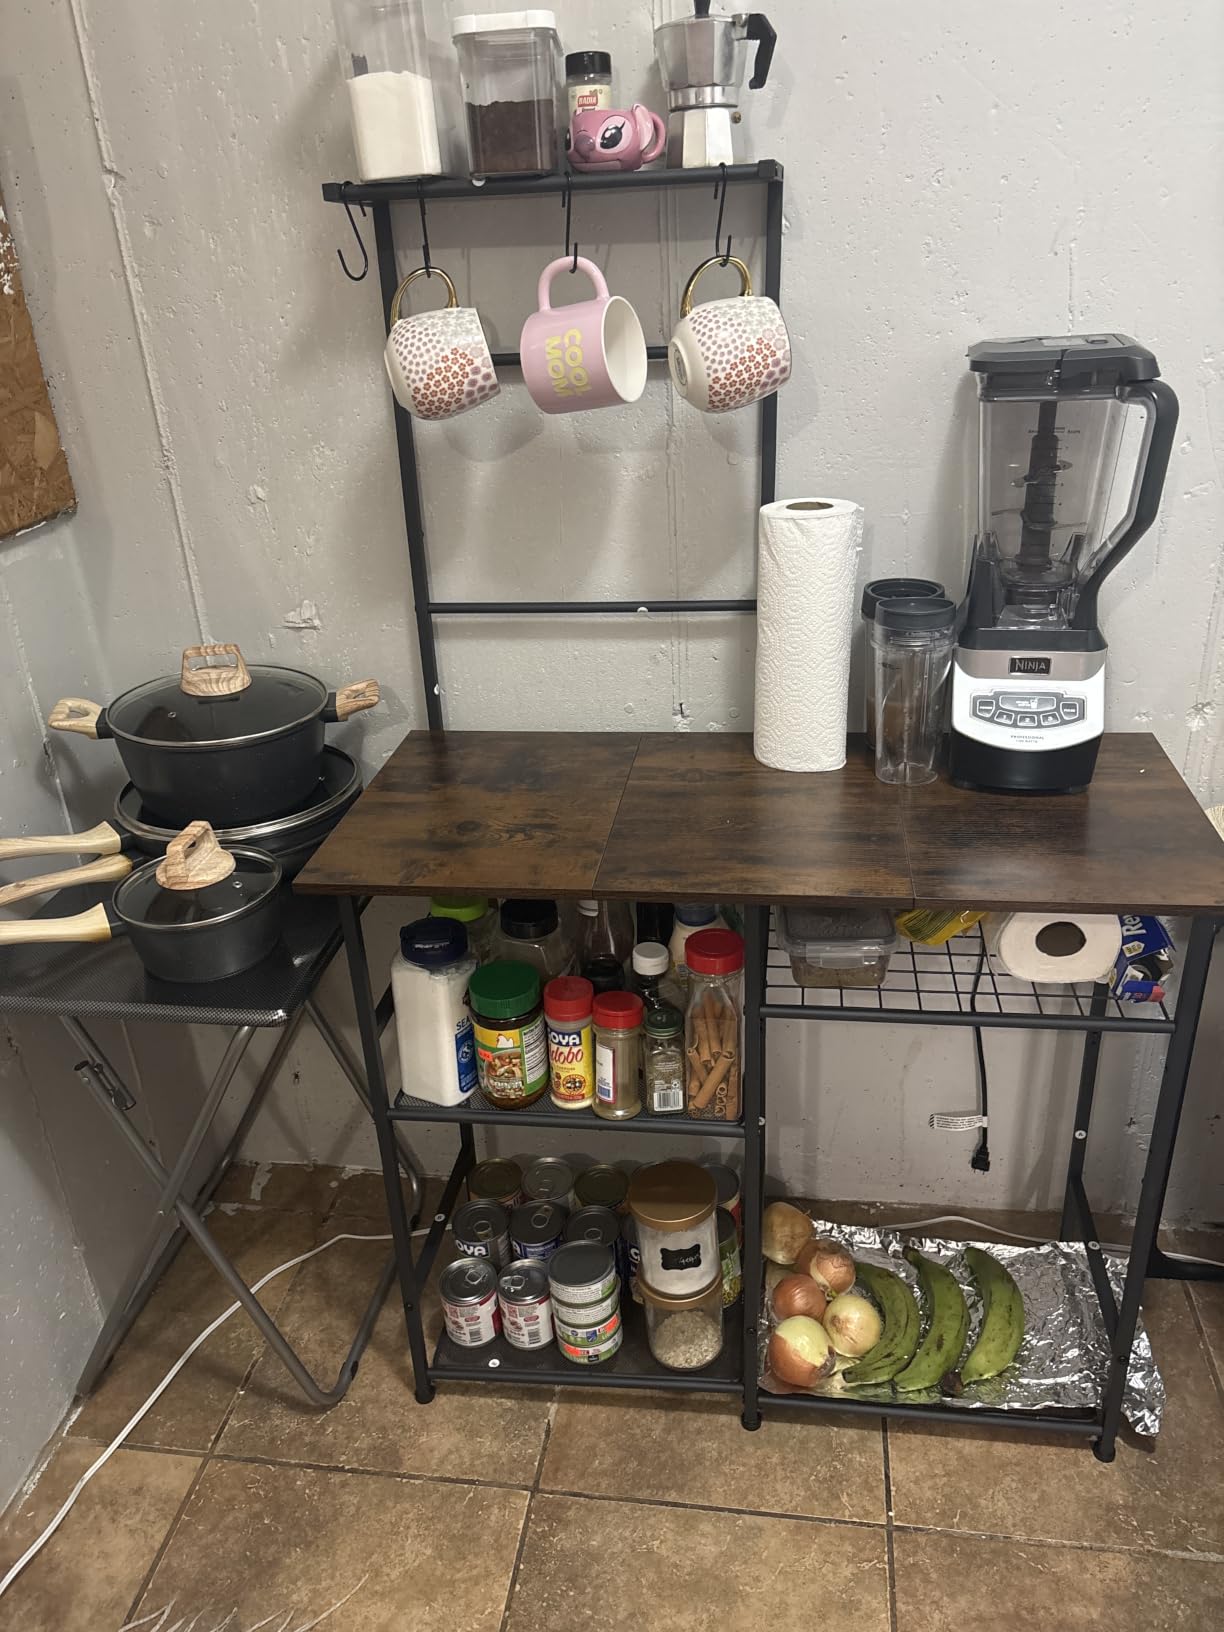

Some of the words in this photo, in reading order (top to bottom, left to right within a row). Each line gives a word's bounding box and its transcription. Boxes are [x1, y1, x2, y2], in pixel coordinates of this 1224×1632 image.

[545, 335, 574, 397] MOM
[564, 328, 592, 395] COOL
[1015, 659, 1046, 672] NINJA
[1122, 915, 1147, 936] Re
[549, 1031, 580, 1046] OYA
[550, 1046, 584, 1065] dobo
[455, 1240, 487, 1256] OYA
